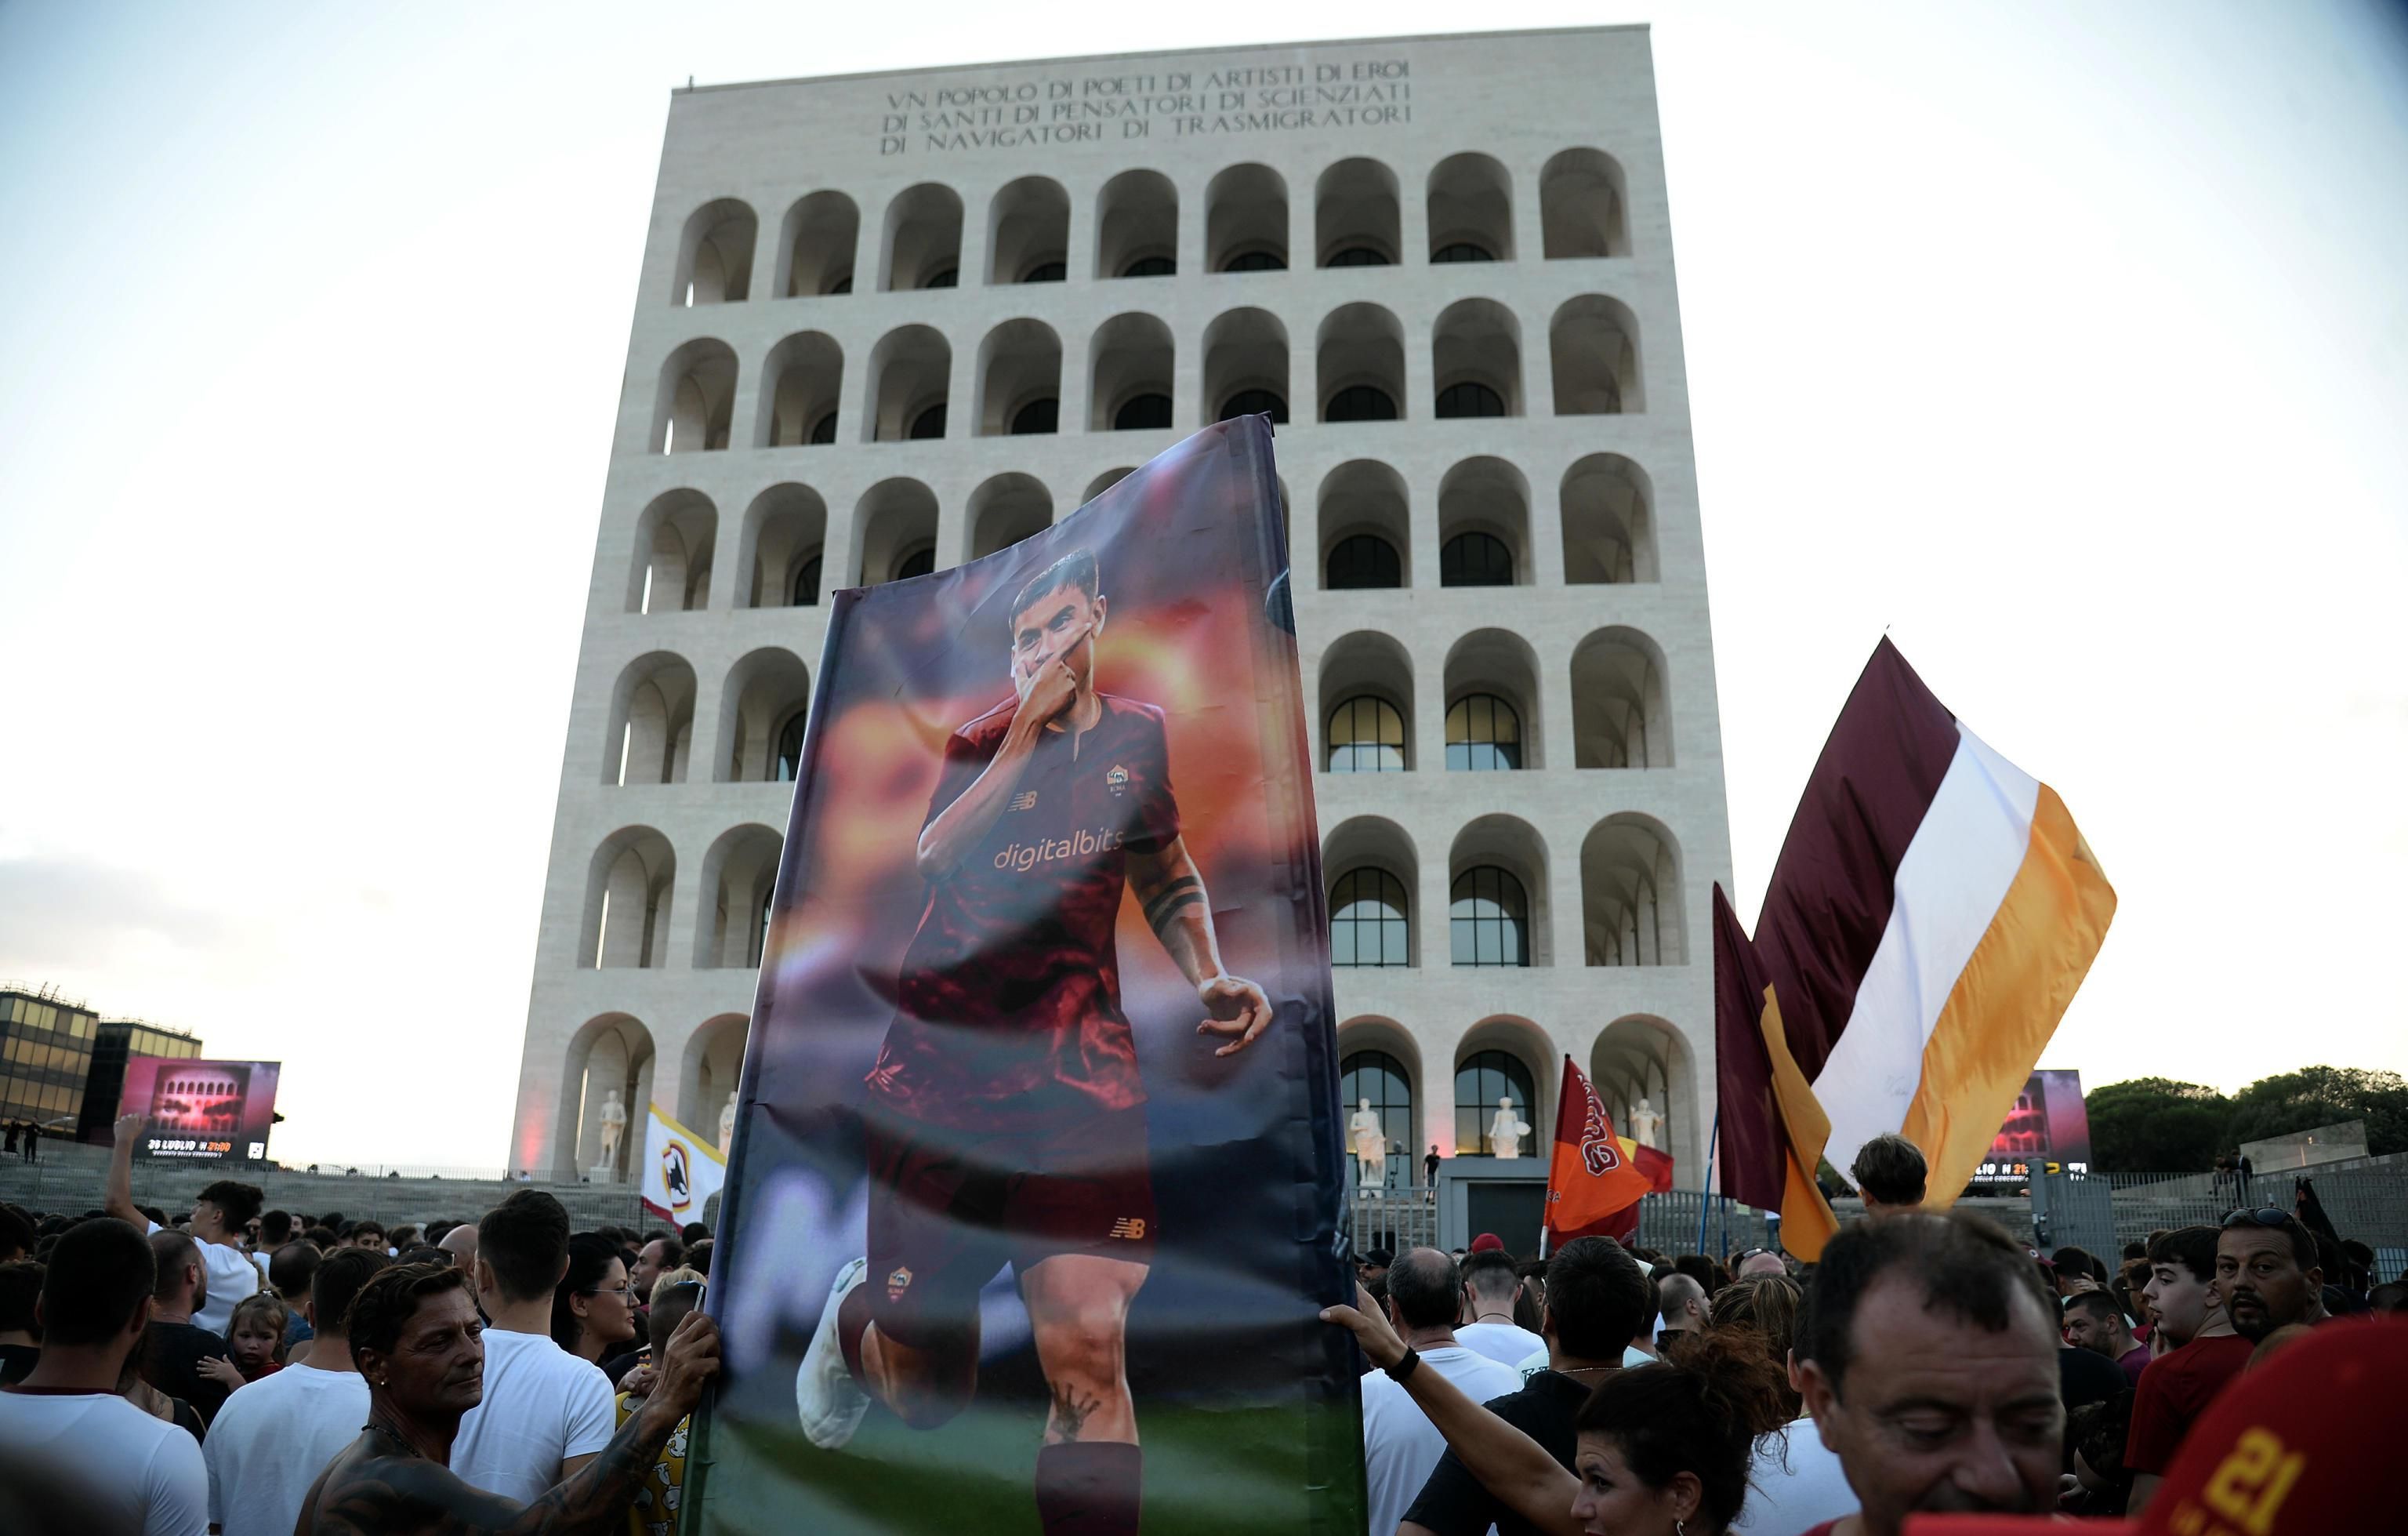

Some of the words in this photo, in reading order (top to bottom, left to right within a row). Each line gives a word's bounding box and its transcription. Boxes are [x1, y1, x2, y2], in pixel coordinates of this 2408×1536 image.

[882, 114, 908, 134] DI
[919, 107, 1003, 132] SANTI
[1014, 103, 1039, 124] DI
[1052, 93, 1206, 121] PENSATORI
[1219, 91, 1246, 111] DI
[1257, 82, 1411, 108] SCIENZIATI
[887, 92, 927, 111] VN
[936, 82, 1039, 107] POPOLO
[1048, 80, 1073, 100] DI
[1083, 75, 1155, 96] POETI
[1167, 73, 1192, 92] DI
[1204, 65, 1304, 90] ARTISTI
[1315, 63, 1341, 83] DI
[1352, 59, 1410, 80] EROI
[879, 136, 906, 156] DI
[926, 120, 1102, 152] NAVIGATORI
[1122, 118, 1149, 140] DI
[1175, 104, 1412, 137] TRASMIGRATORI
[993, 826, 1126, 873] digitalbits
[162, 1139, 197, 1151] LUGLIO
[2203, 1425, 2307, 1536] 21
